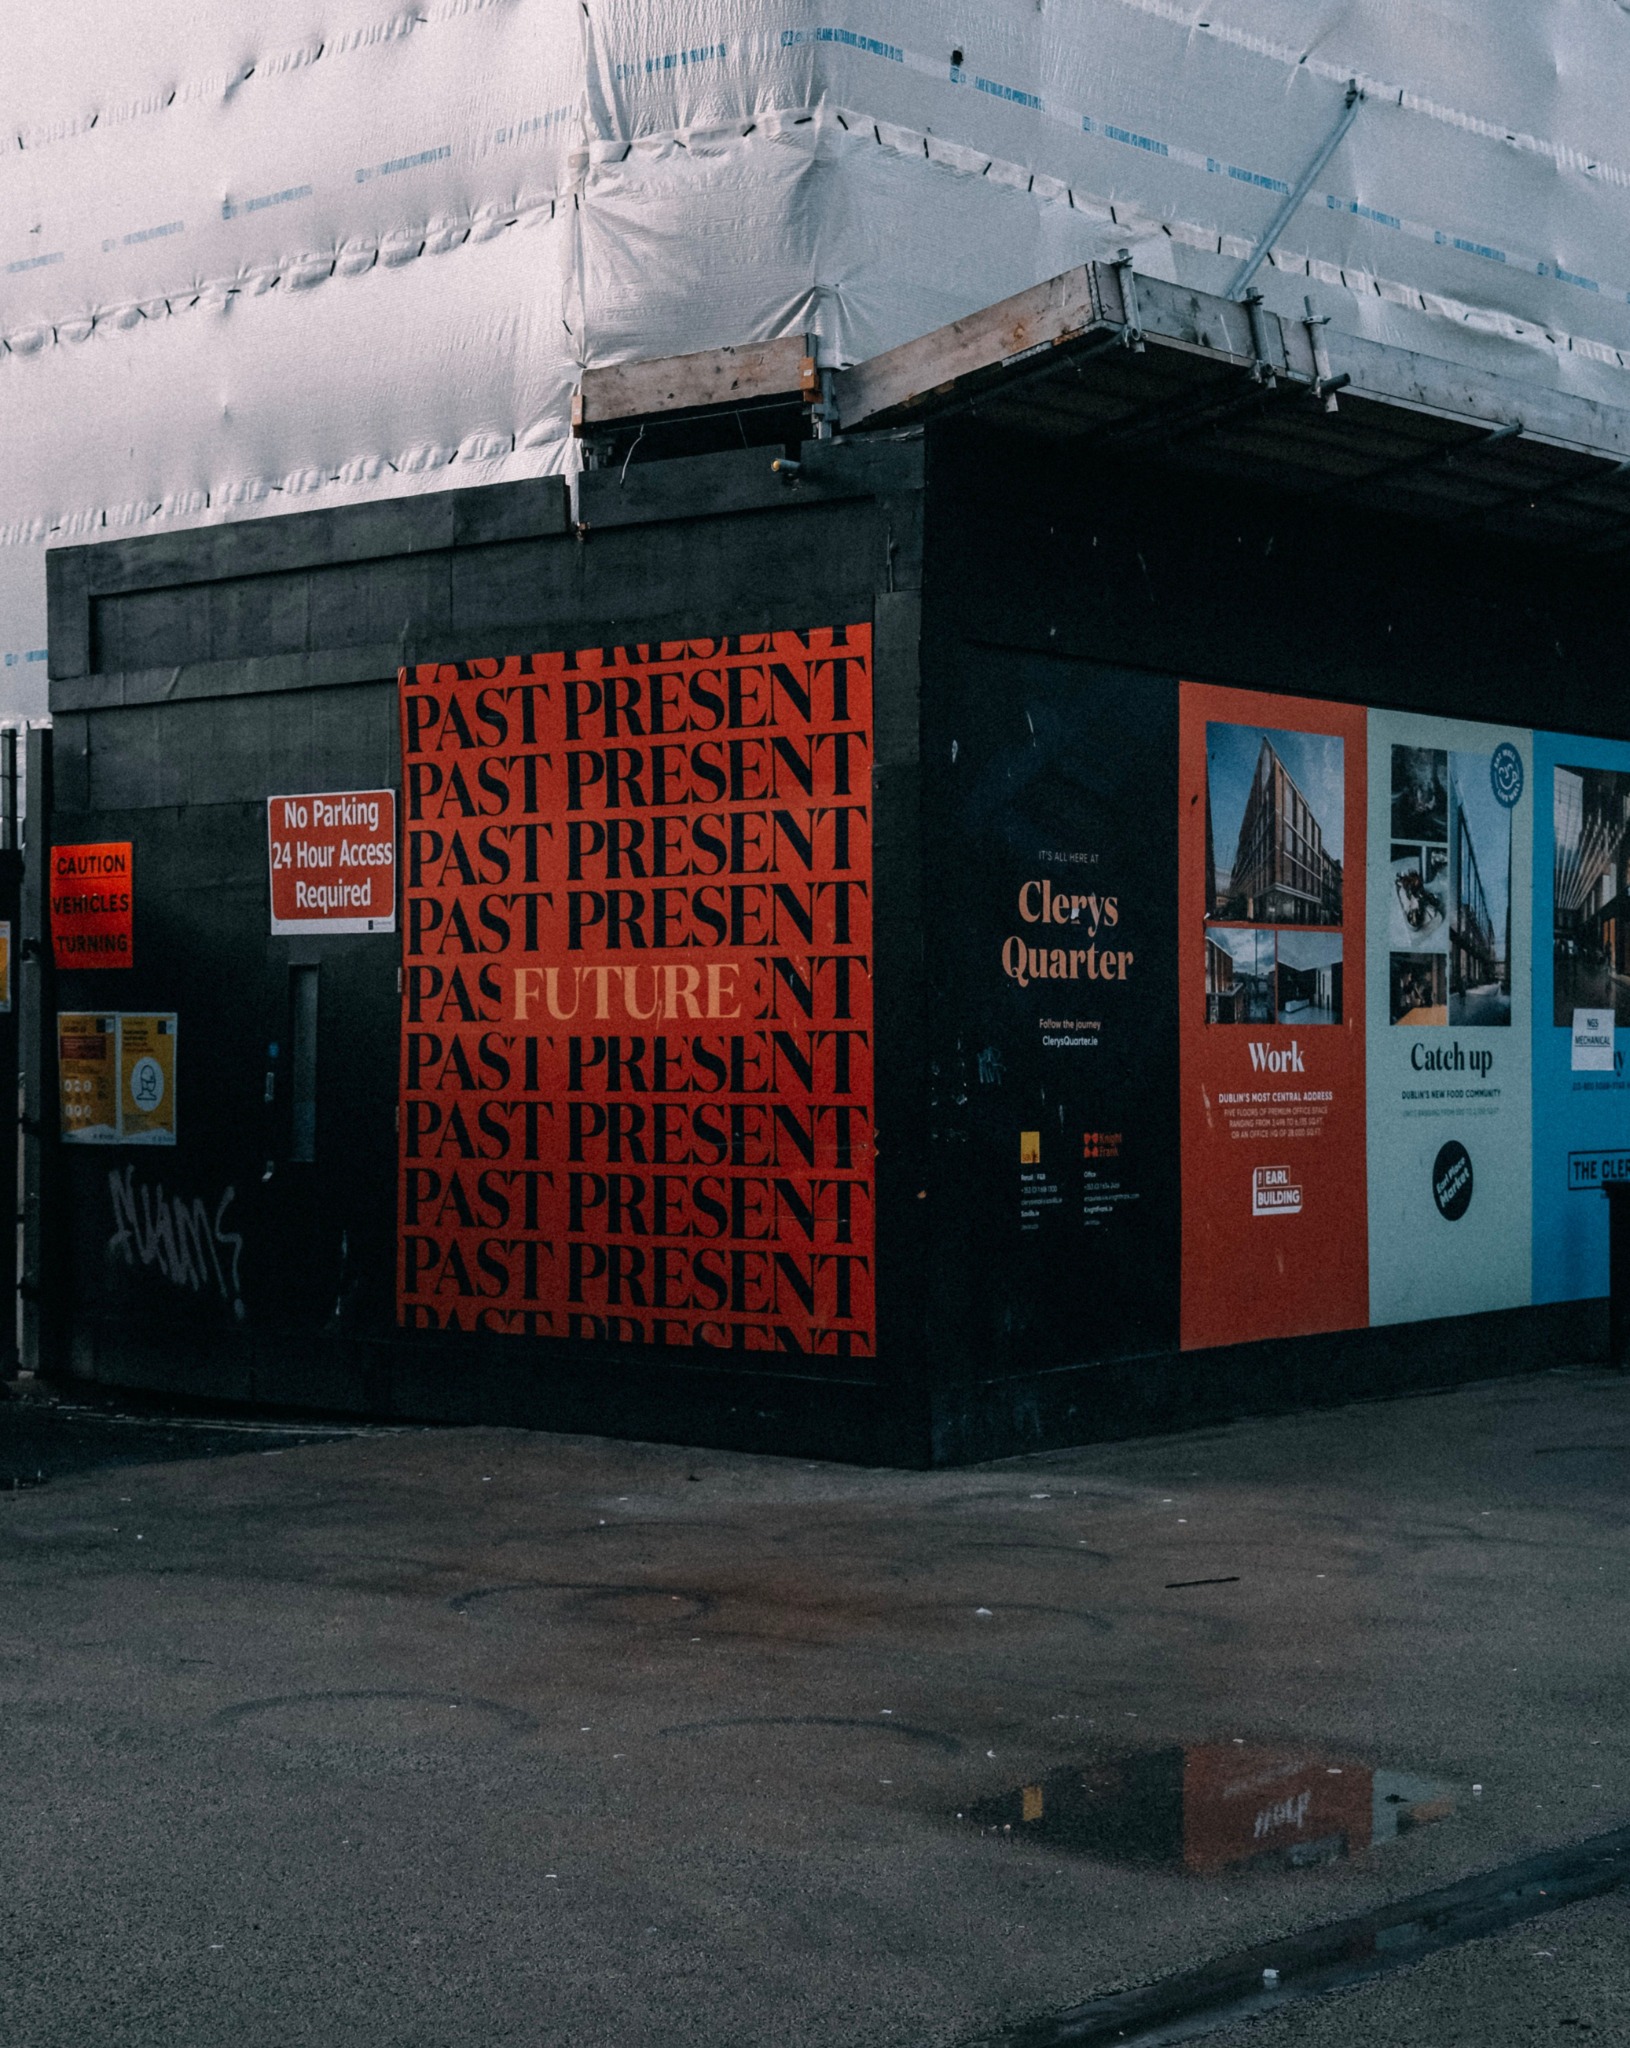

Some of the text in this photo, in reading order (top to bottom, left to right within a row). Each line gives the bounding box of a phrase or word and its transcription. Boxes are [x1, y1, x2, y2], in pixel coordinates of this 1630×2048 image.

[406, 656, 866, 753] PAST PRESENT
[408, 731, 868, 820] PAST PRESENT
[284, 796, 379, 832] No Parking
[56, 854, 125, 875] CAUTION
[272, 839, 393, 870] 24 Hour Access
[408, 806, 867, 888] PAST PRESENT
[1054, 851, 1067, 862] ALL
[1069, 853, 1088, 864] HERE
[1090, 853, 1099, 864] AT
[53, 894, 129, 914] VEHICLES
[295, 877, 371, 914] Required
[1018, 879, 1119, 937] Clerys
[408, 881, 867, 955] PAST PRESENT
[56, 934, 128, 953] TURNING
[1002, 936, 1134, 988] Quarter
[514, 964, 740, 1020] FUTURE
[1039, 1018, 1101, 1031] Follow the journey
[1042, 1035, 1099, 1048] ClerysQuarter.ie
[406, 1031, 868, 1094] PAST PRESENT
[1248, 1040, 1305, 1073] Work
[1410, 1041, 1493, 1078] Catch up
[1218, 1091, 1333, 1103] DUBLIN'S MOST CENTRAL ADDRESS
[1431, 1089, 1445, 1099] NEW
[1446, 1089, 1464, 1098] FOOD
[1465, 1088, 1501, 1098] COMMUNITY
[405, 1100, 868, 1169] PAST PRESENT
[1265, 1170, 1288, 1185] EARL
[1439, 1167, 1470, 1208] Market
[1573, 1161, 1597, 1180] THE
[404, 1168, 869, 1243] PAST PRESENT
[1257, 1190, 1300, 1206] BUILDING
[403, 1235, 869, 1318] PAST PRESENT
